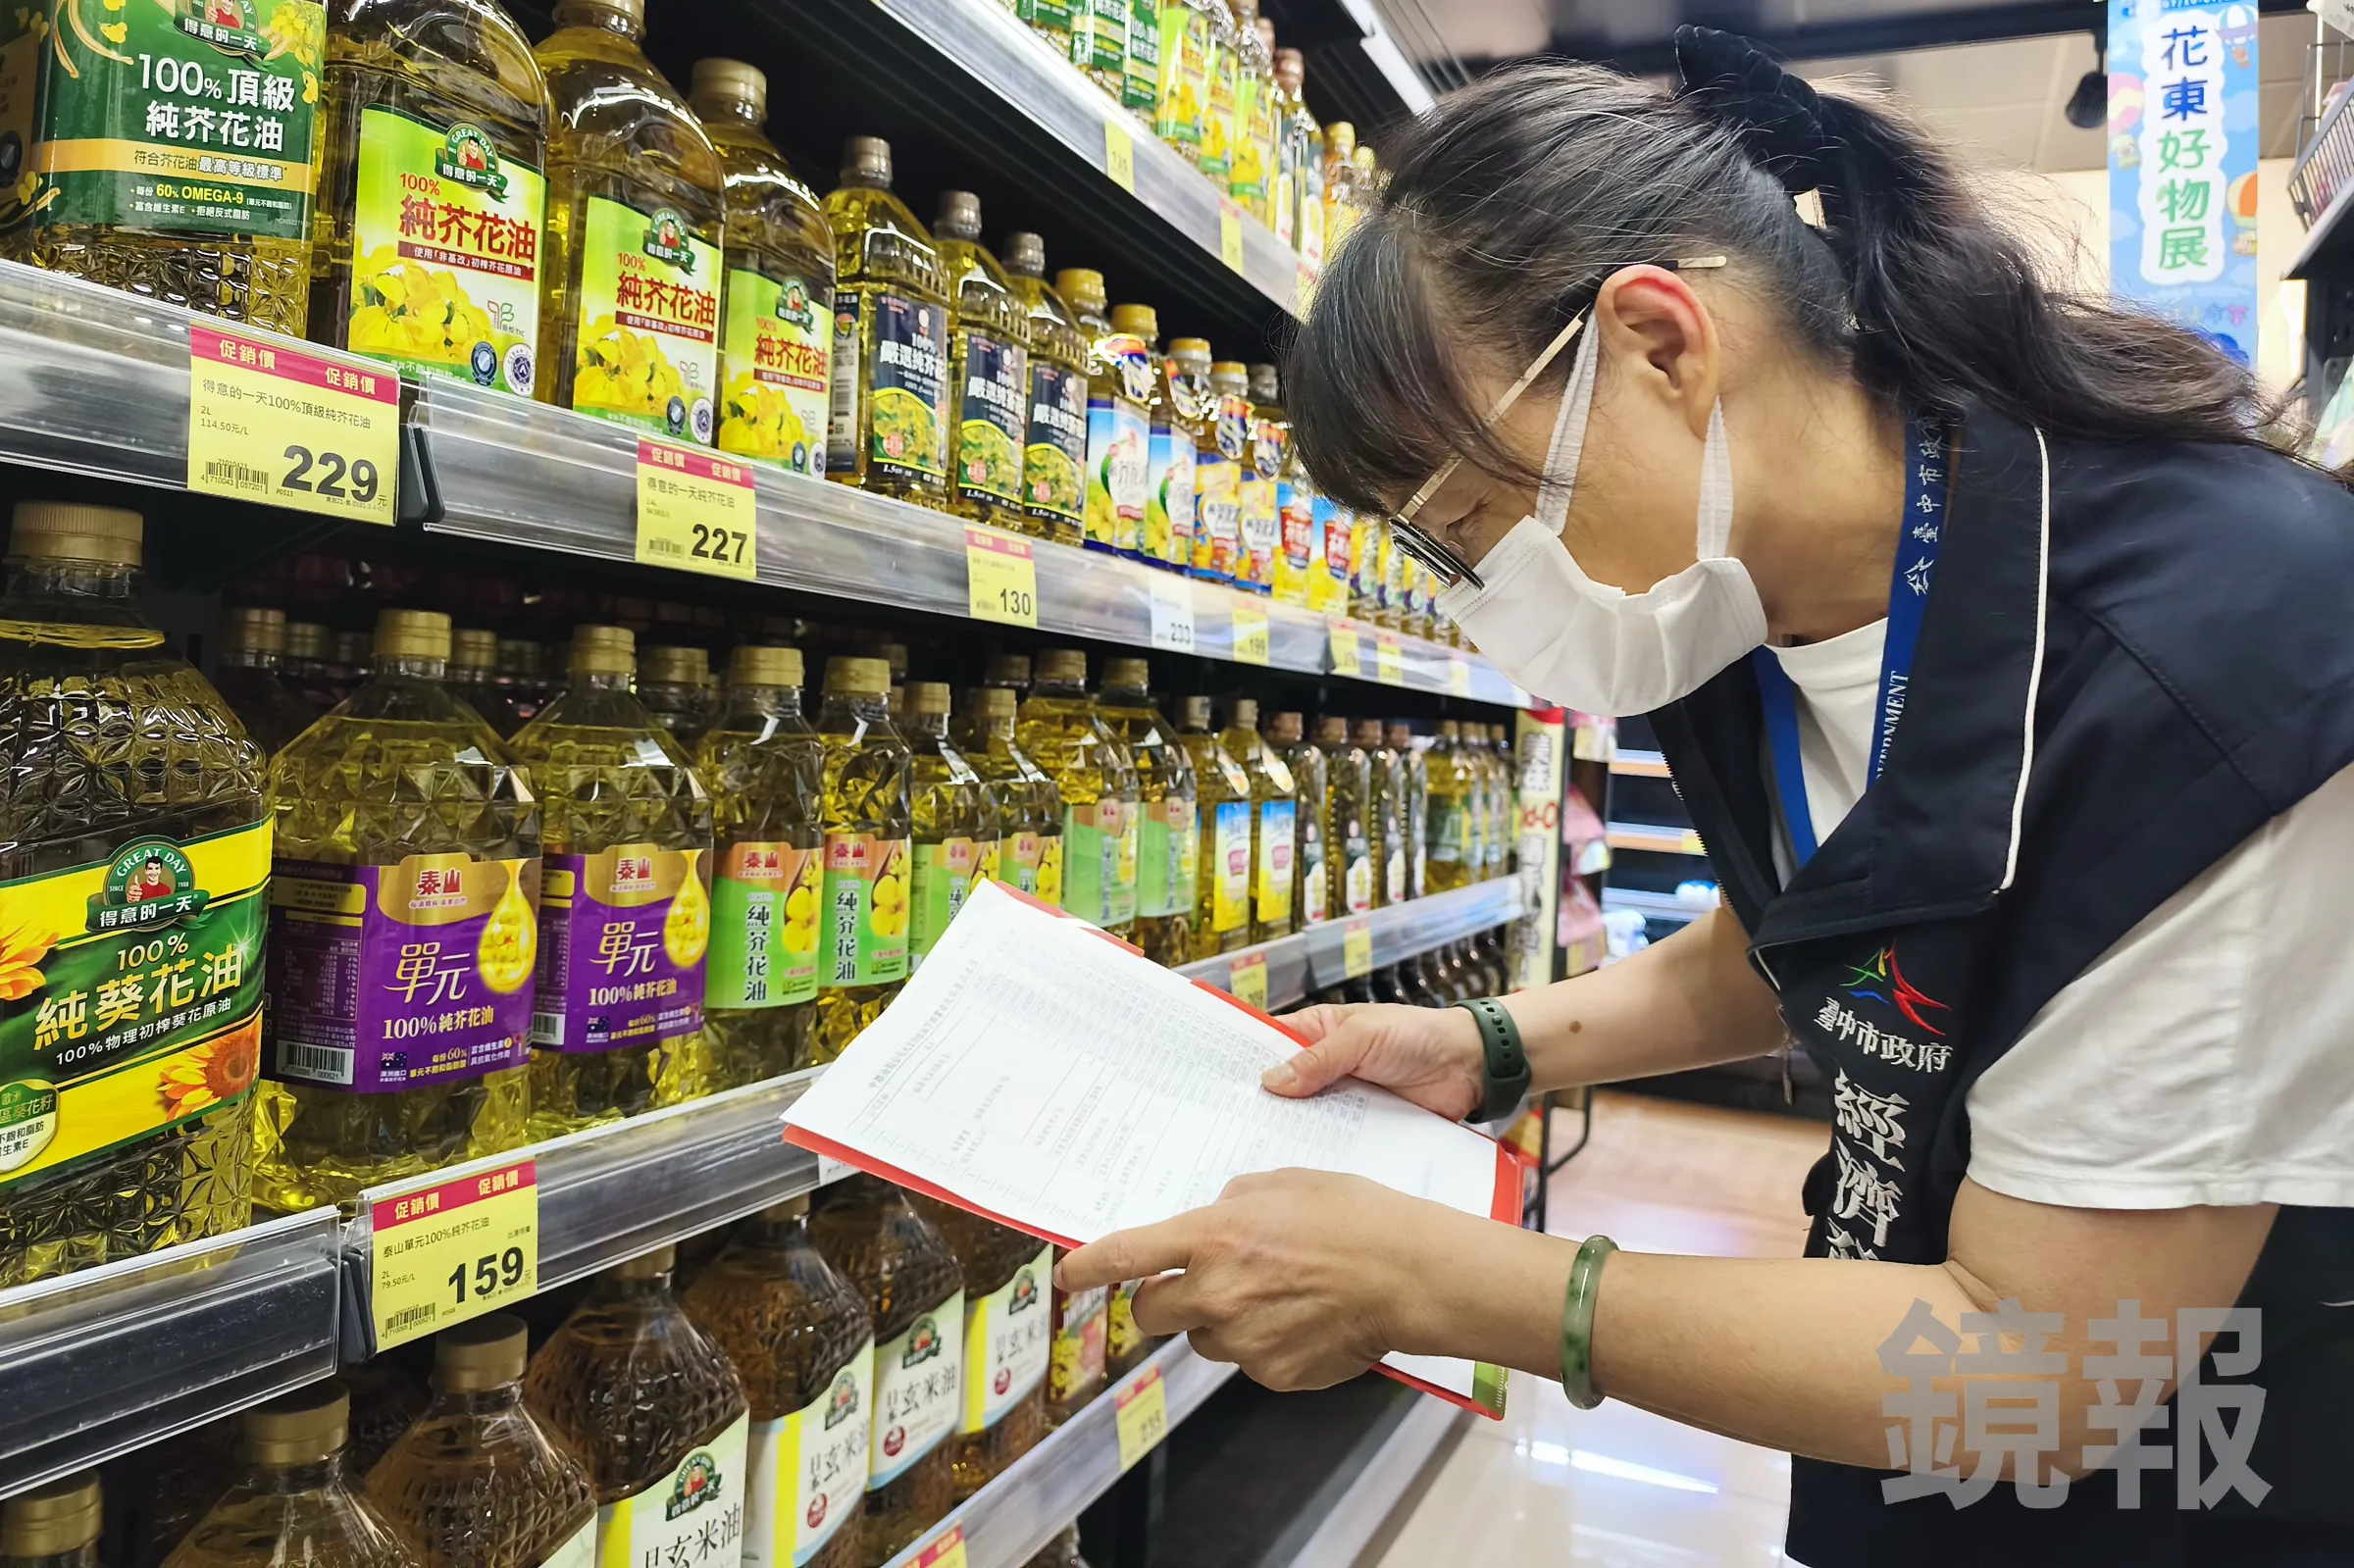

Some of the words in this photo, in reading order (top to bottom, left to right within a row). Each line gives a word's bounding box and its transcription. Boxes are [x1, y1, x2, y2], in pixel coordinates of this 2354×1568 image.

[184, 17, 257, 50] 得意的一天
[145, 100, 284, 152] 純芥花油
[451, 127, 479, 144] GREAT
[479, 137, 494, 158] DAY
[2157, 25, 2211, 271] 花東好物展
[400, 173, 440, 196] 100%
[442, 164, 498, 186] 得意的一天
[156, 183, 179, 199] 60%
[181, 186, 244, 205] OMEGA-9
[399, 193, 537, 263] 純芥花油
[617, 252, 646, 272] 100%
[616, 271, 716, 328] 純芥花油
[219, 339, 276, 371] 促銷價
[325, 367, 376, 395] 促銷價
[754, 333, 828, 378] 純芥花油
[200, 406, 212, 416] 2L
[202, 379, 371, 430] 得意的一天100%頂級純芥花油
[200, 418, 249, 435] 114.50元/L
[281, 444, 379, 503] 229
[651, 447, 686, 468] 促銷價
[711, 462, 742, 482] 促銷價
[210, 476, 234, 487] 710043
[239, 481, 263, 492] 057201
[378, 494, 387, 507] 元
[647, 477, 736, 509] 得意的一天純芥花油
[691, 524, 747, 564] 227
[999, 588, 1031, 616] 130
[1170, 623, 1191, 644] 233
[117, 847, 161, 878] GREAT
[163, 851, 187, 875] DAY
[744, 851, 779, 869] 泰山
[835, 842, 866, 858] 泰山
[417, 868, 462, 896] 泰山
[617, 856, 651, 881] 泰山
[109, 885, 125, 893] SINCE
[99, 894, 193, 929] 得意的一天
[117, 932, 189, 971] 100%
[589, 921, 658, 977] 單元
[382, 941, 471, 1006] 單元
[33, 944, 243, 1050] 純葵花油
[588, 978, 678, 1006] 100%純芥花油
[55, 997, 232, 1066] 100%物理初榨葵花原油
[382, 1005, 494, 1039] 100%純芥花油
[1814, 996, 1954, 1074] 臺中市政府
[395, 1191, 439, 1221] 促銷價
[478, 1169, 519, 1196] 促銷價
[383, 1216, 489, 1258] 泰山單元100%純芥花油
[382, 1273, 415, 1290] 79.50元/L
[448, 1246, 524, 1304] 159
